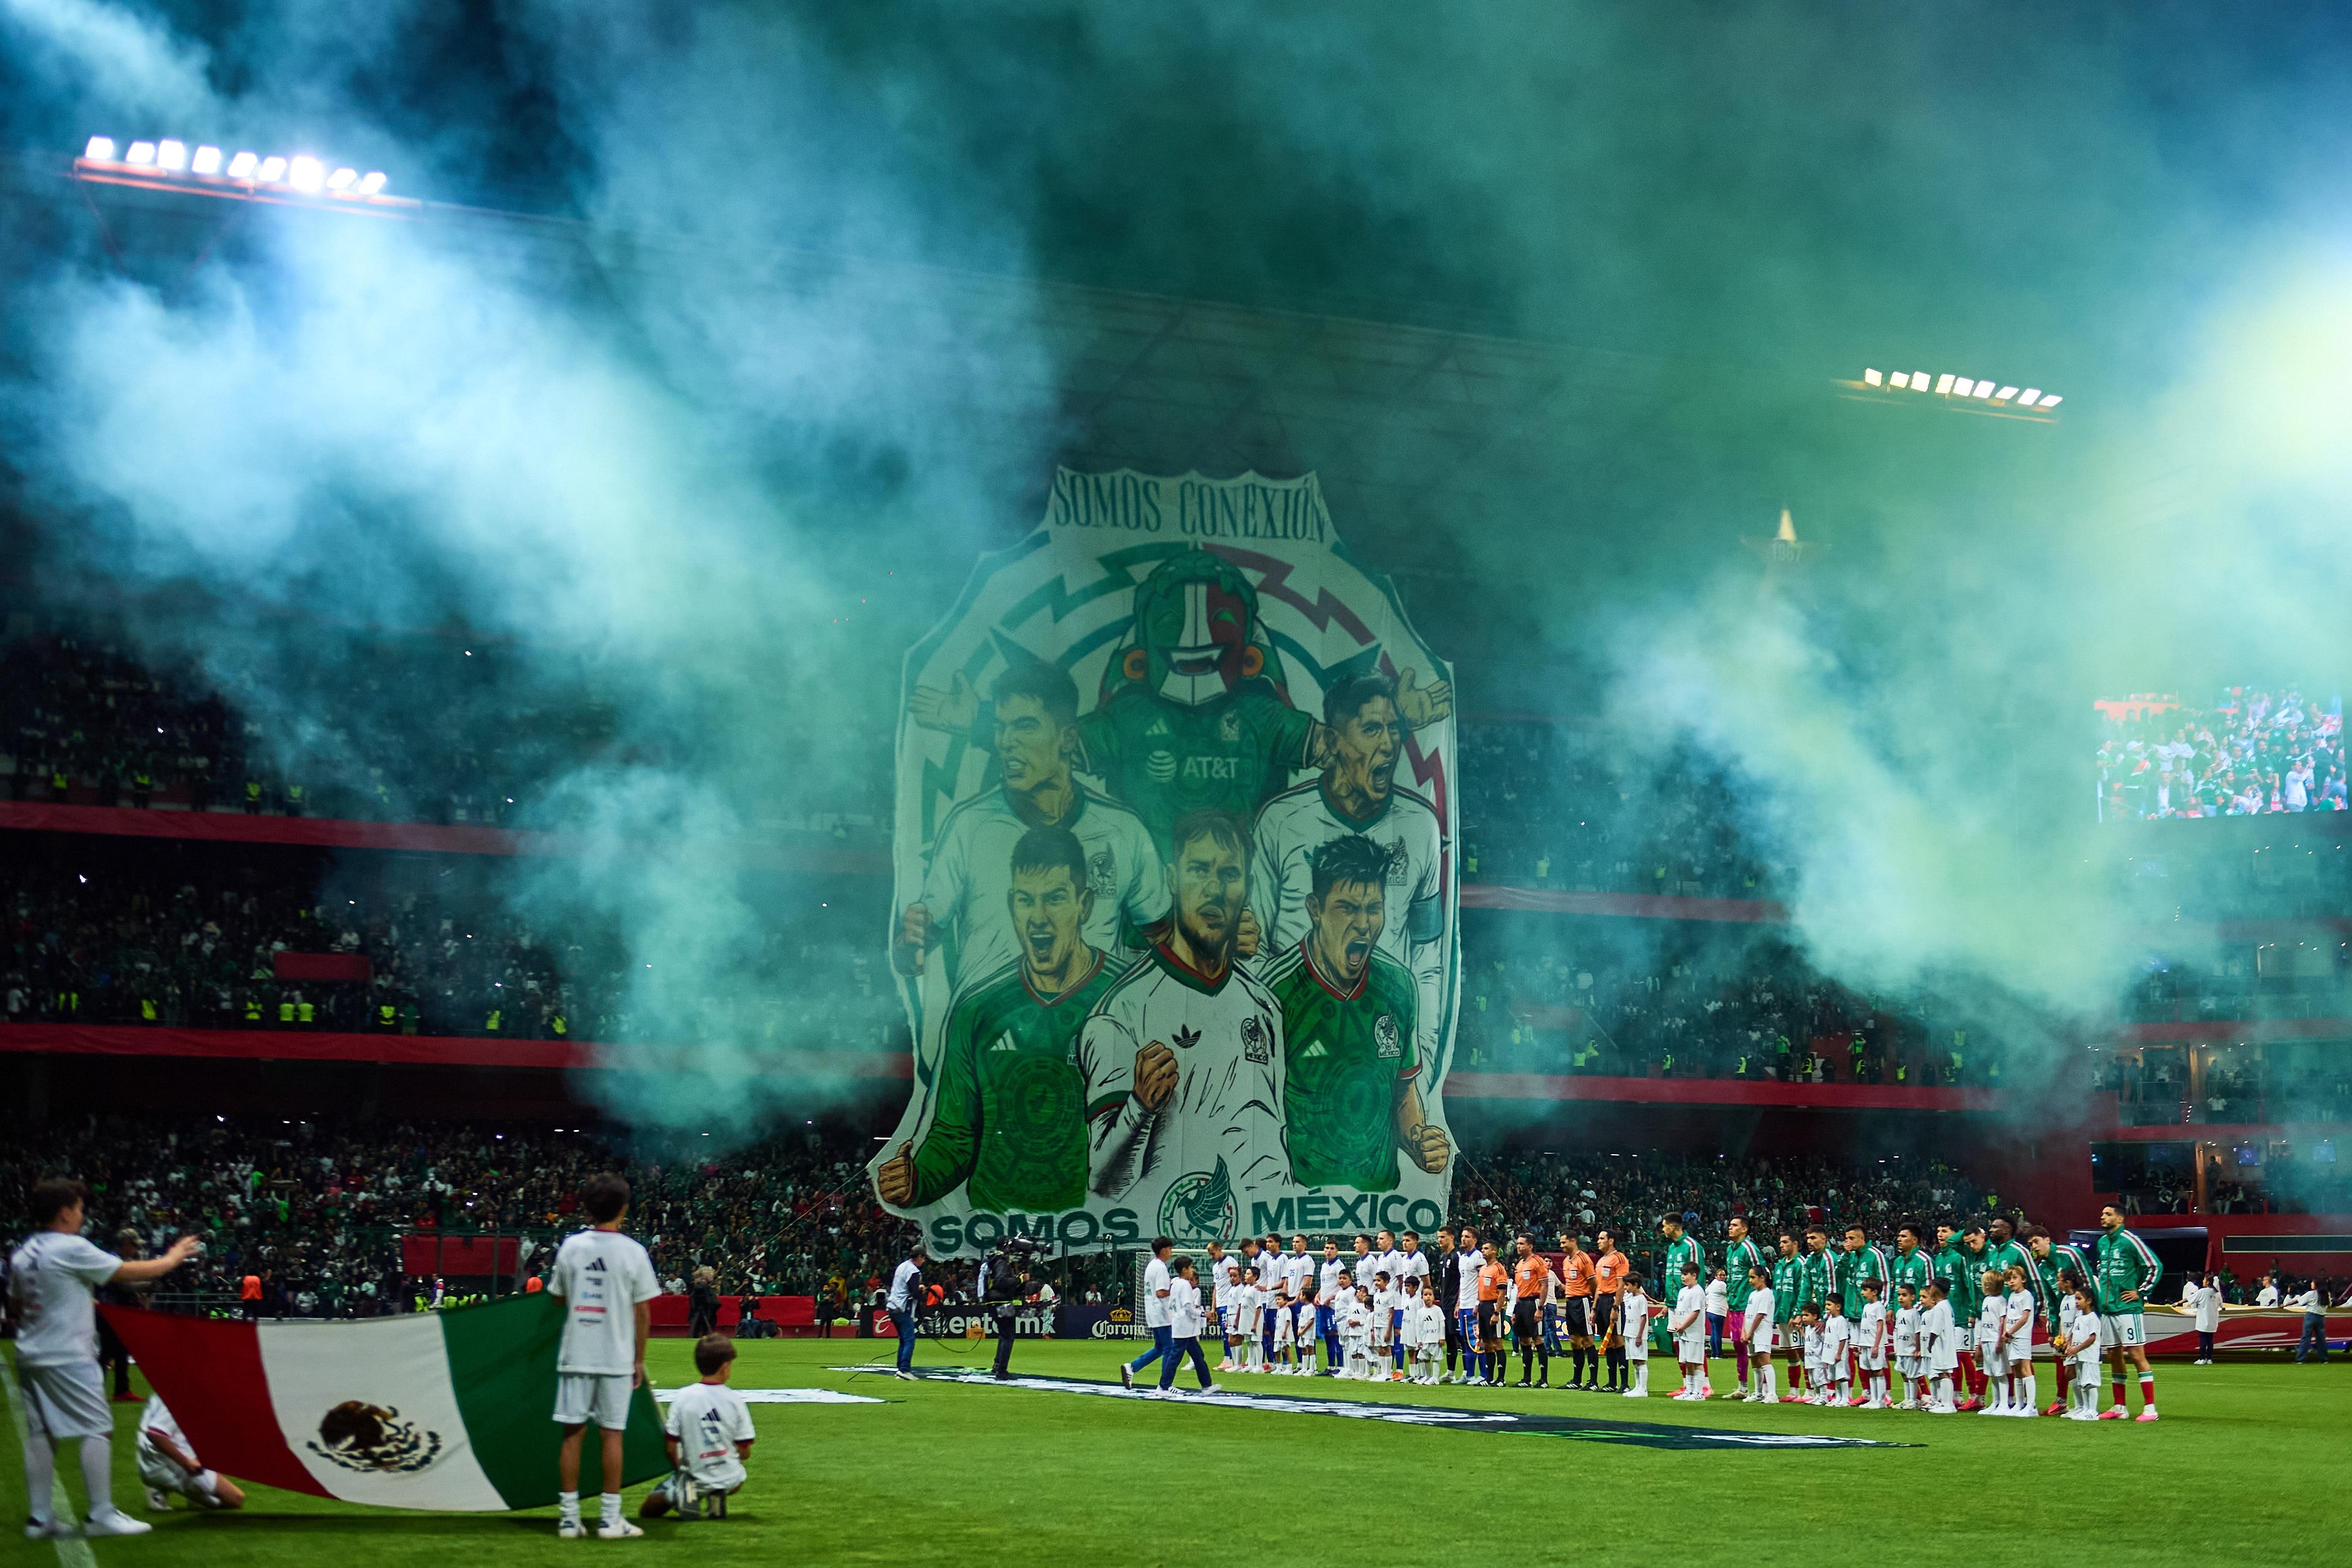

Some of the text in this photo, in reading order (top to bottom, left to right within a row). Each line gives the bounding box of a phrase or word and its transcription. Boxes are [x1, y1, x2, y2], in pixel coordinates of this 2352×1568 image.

[1055, 471, 1325, 543] SOMOS CONEXIÓN
[1183, 757, 1239, 779] AT&T
[931, 1187, 1442, 1253] SOMOS MÉXICO
[1092, 1320, 1146, 1339] Corona
[2127, 1328, 2134, 1340] 9
[1963, 1334, 1969, 1346] 2
